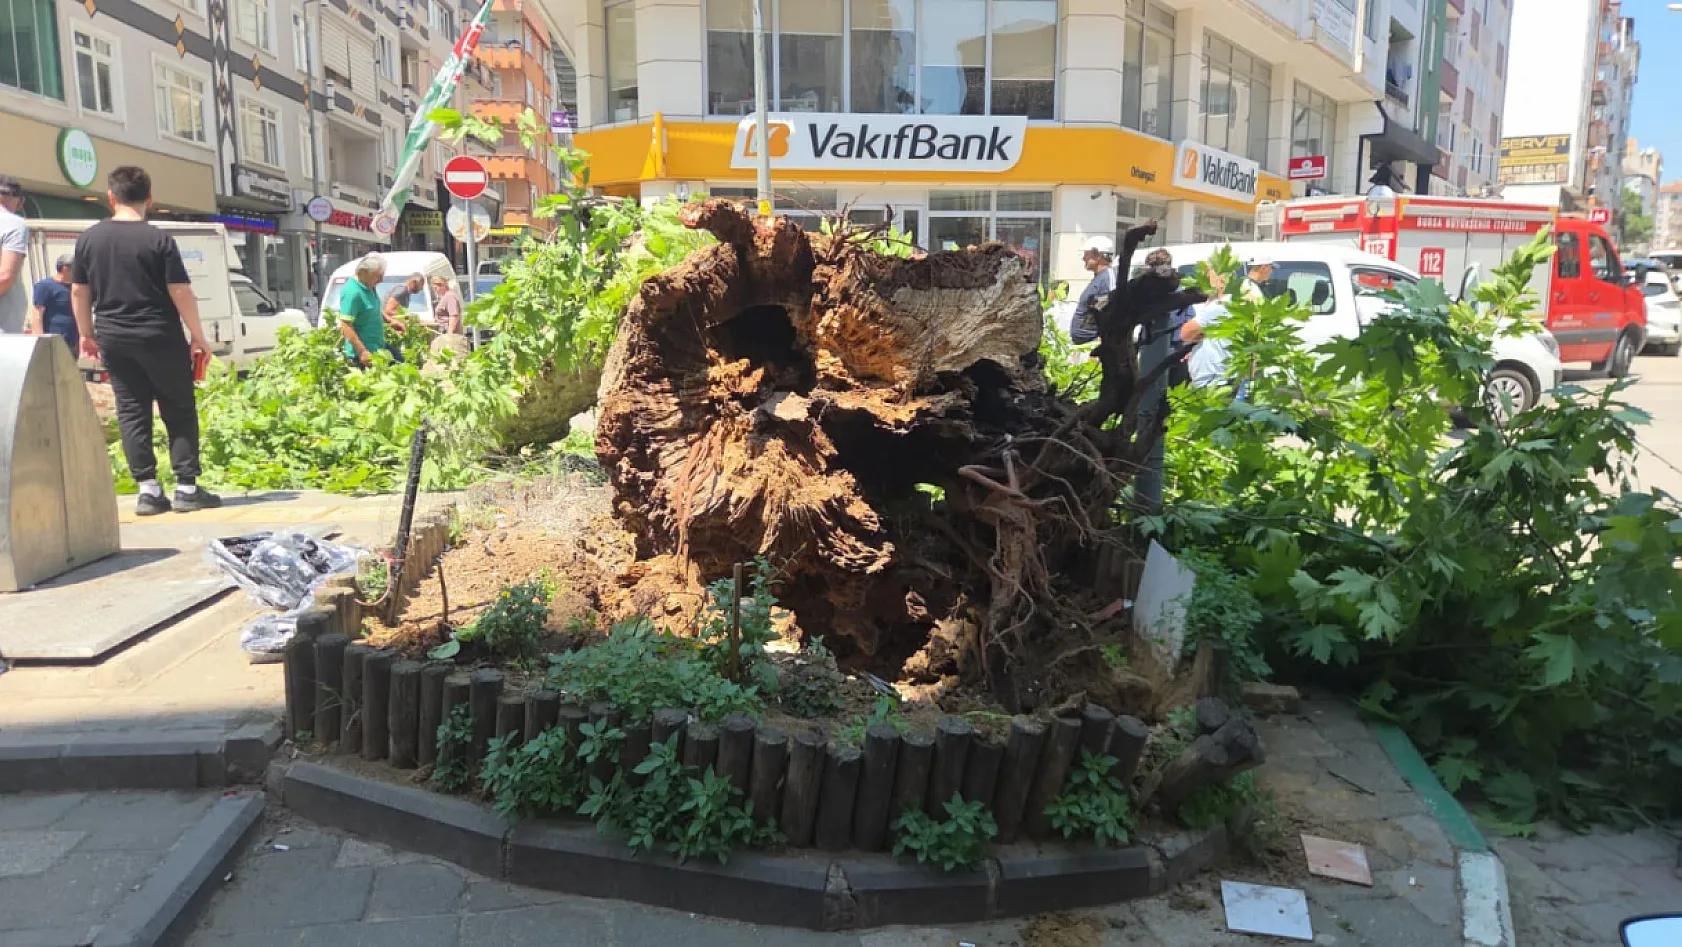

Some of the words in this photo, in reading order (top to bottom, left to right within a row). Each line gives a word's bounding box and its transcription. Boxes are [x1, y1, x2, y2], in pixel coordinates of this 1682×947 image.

[808, 122, 1013, 161] VakıfBank
[1202, 152, 1257, 196] VakıfBank
[1368, 242, 1386, 255] 112
[1423, 251, 1441, 273] 112
